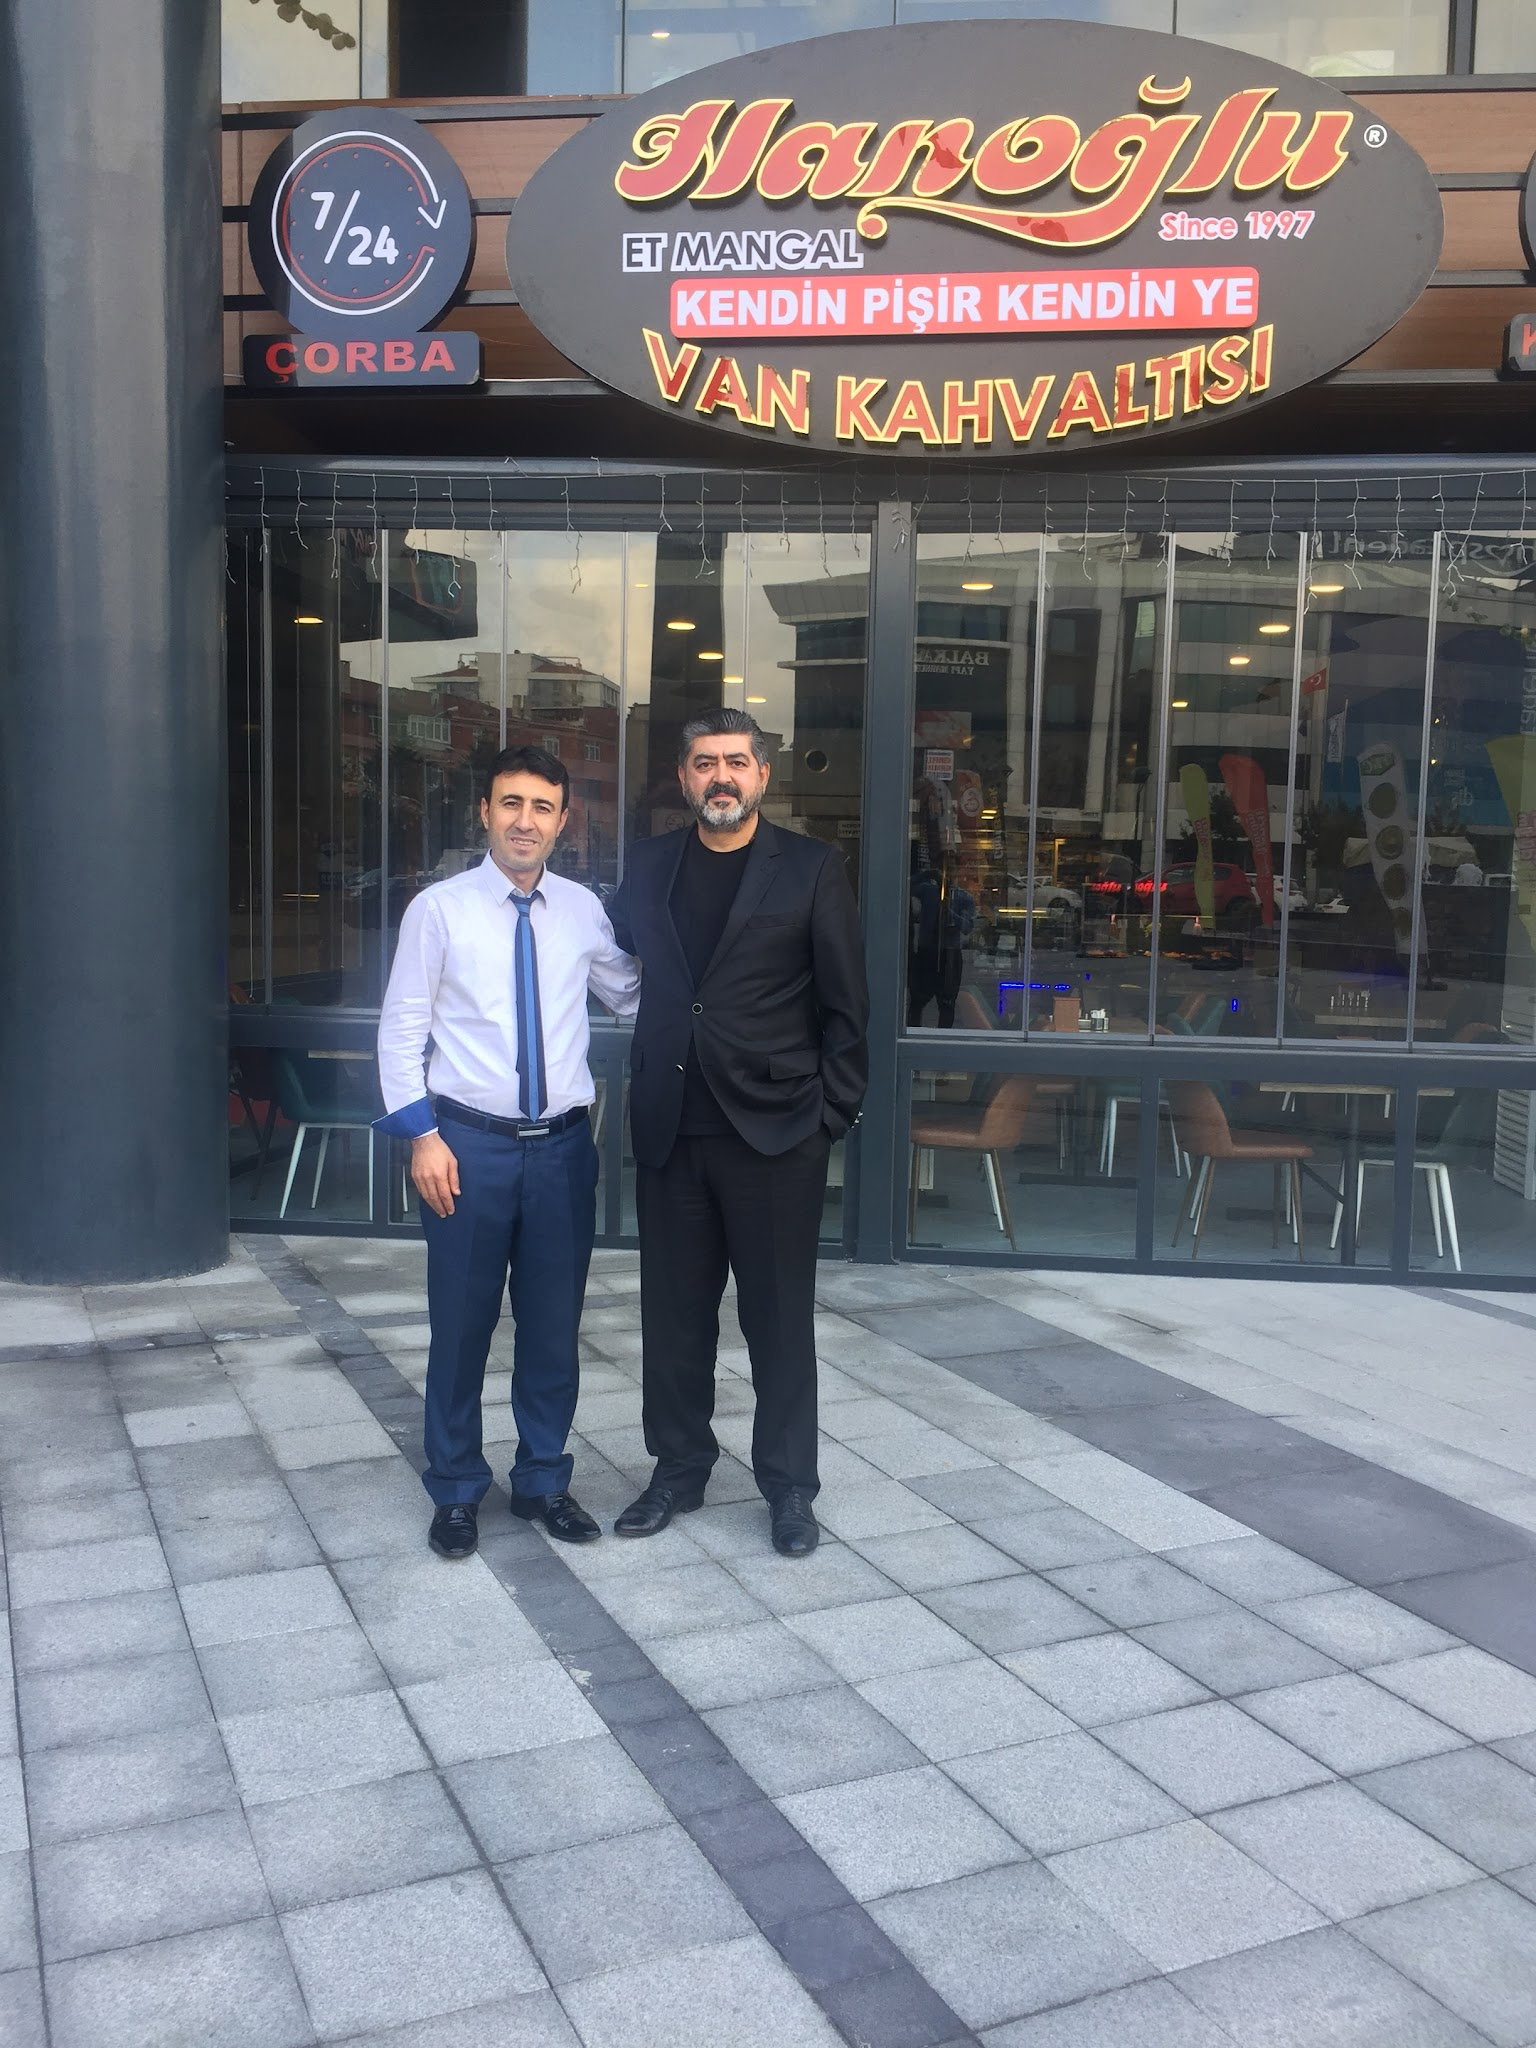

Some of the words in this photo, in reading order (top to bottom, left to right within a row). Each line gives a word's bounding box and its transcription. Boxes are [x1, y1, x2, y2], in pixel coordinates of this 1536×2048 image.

[615, 75, 1354, 248] Hanoğlu
[310, 190, 399, 265] 7/24
[622, 233, 668, 273] ET
[670, 229, 865, 272] MANGAL
[1158, 211, 1239, 242] Since
[1243, 210, 1316, 241] 1997
[676, 281, 847, 327] KENDİN
[863, 277, 982, 333] PİŞİR
[997, 272, 1176, 321] KENDİN
[1191, 278, 1254, 316] YE
[264, 341, 456, 383] ÇORBA
[642, 328, 810, 436] VAN
[835, 324, 1275, 444] KAHVALTISI
